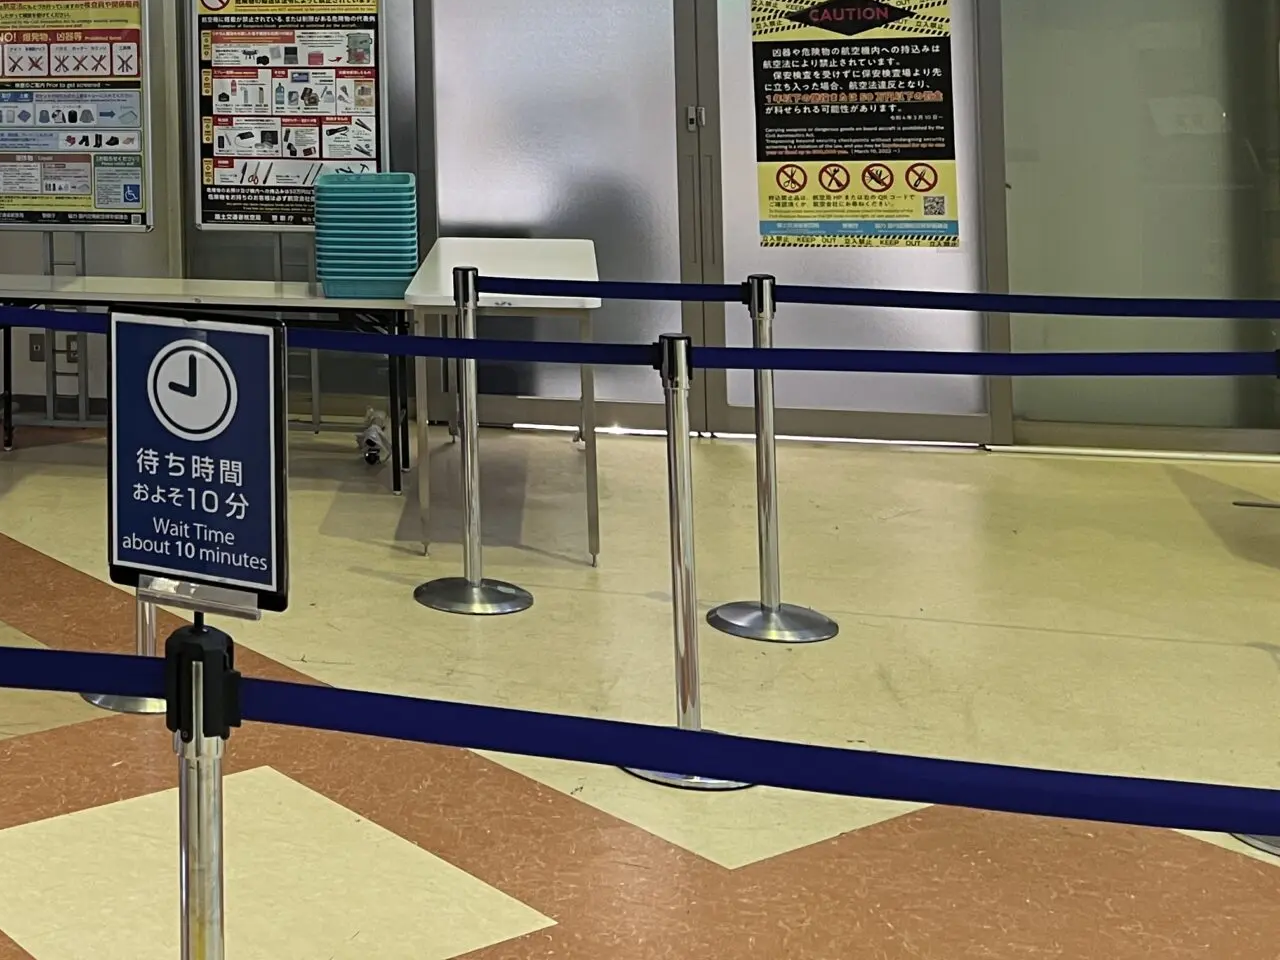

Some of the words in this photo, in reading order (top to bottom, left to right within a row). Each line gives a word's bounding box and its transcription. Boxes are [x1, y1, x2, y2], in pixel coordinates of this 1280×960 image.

[808, 7, 889, 23] CAUTION
[796, 236, 817, 244] KEEP
[821, 237, 837, 245] OUT
[136, 447, 243, 487] 待ち時間
[132, 482, 250, 520] およそ10分
[152, 516, 190, 539] Wait
[193, 523, 236, 546] Time
[122, 532, 170, 556] about
[175, 540, 196, 559] 10
[199, 546, 268, 571] minutes
